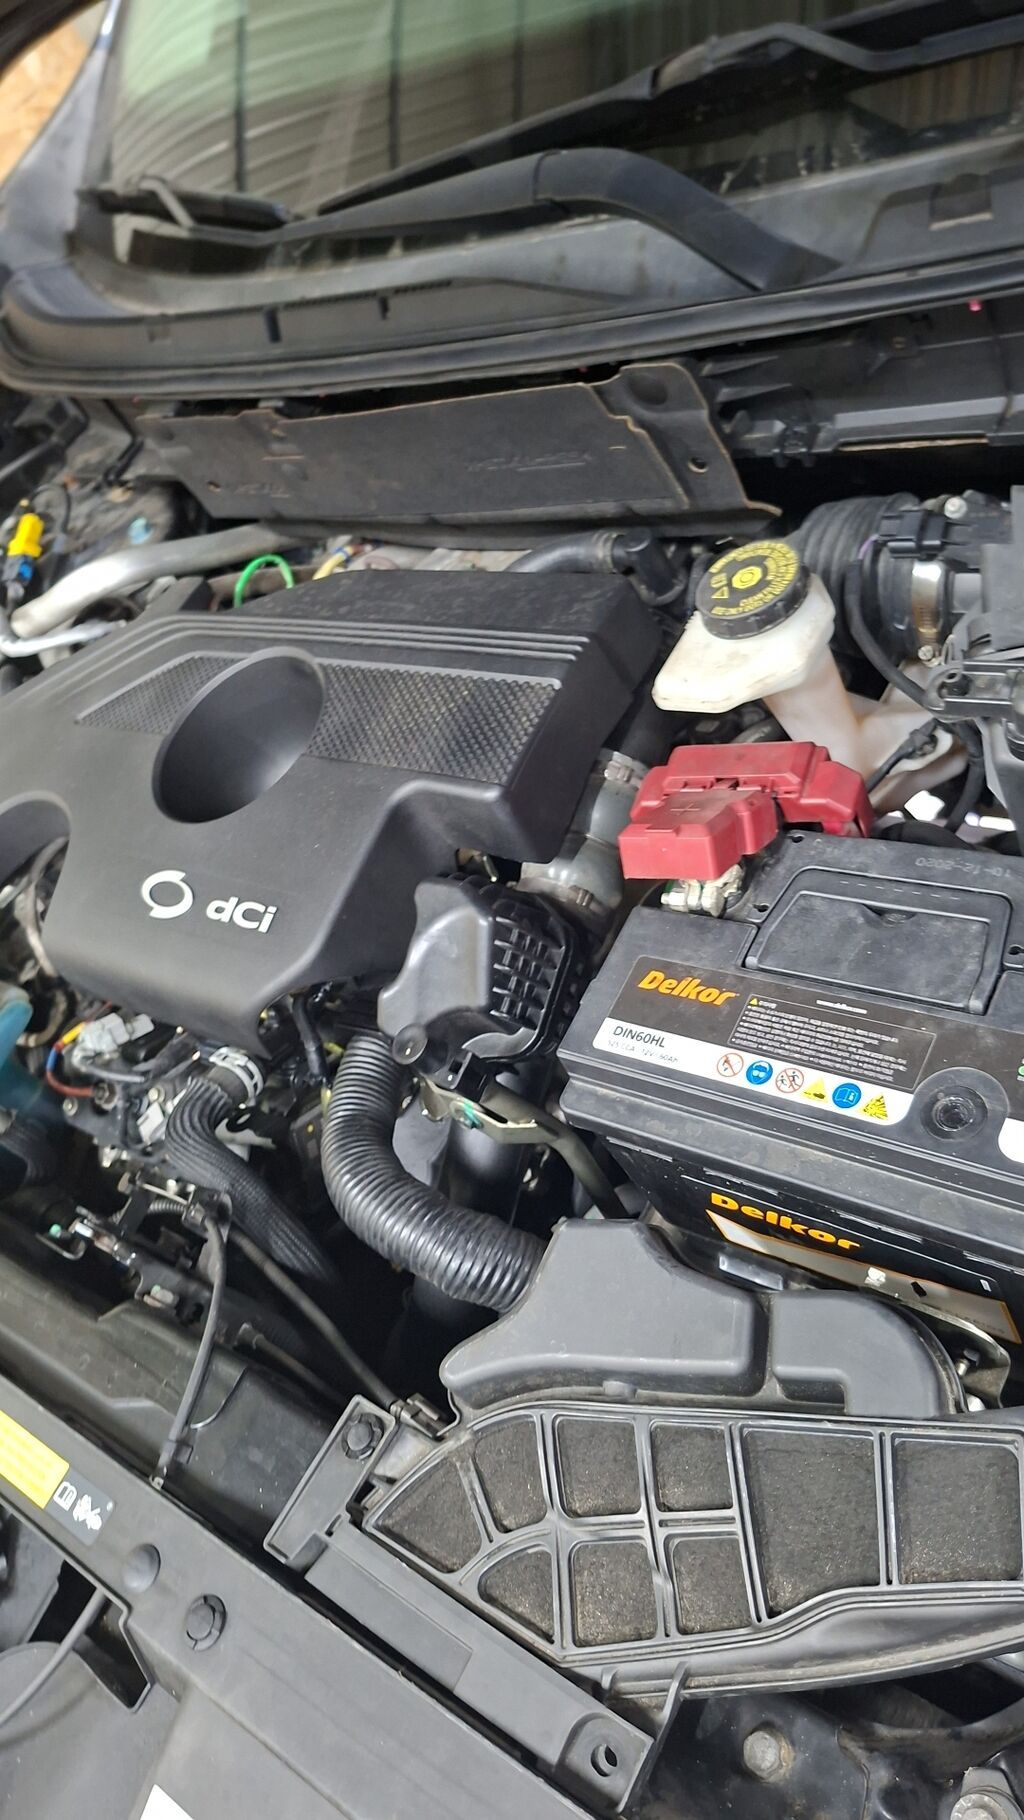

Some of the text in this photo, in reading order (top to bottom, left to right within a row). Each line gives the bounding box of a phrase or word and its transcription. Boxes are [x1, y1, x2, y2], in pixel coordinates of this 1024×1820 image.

[206, 896, 278, 933] dCi
[638, 970, 737, 1006] Delkor
[612, 1025, 666, 1048] DIN60HL
[711, 1192, 861, 1249] Delkor
